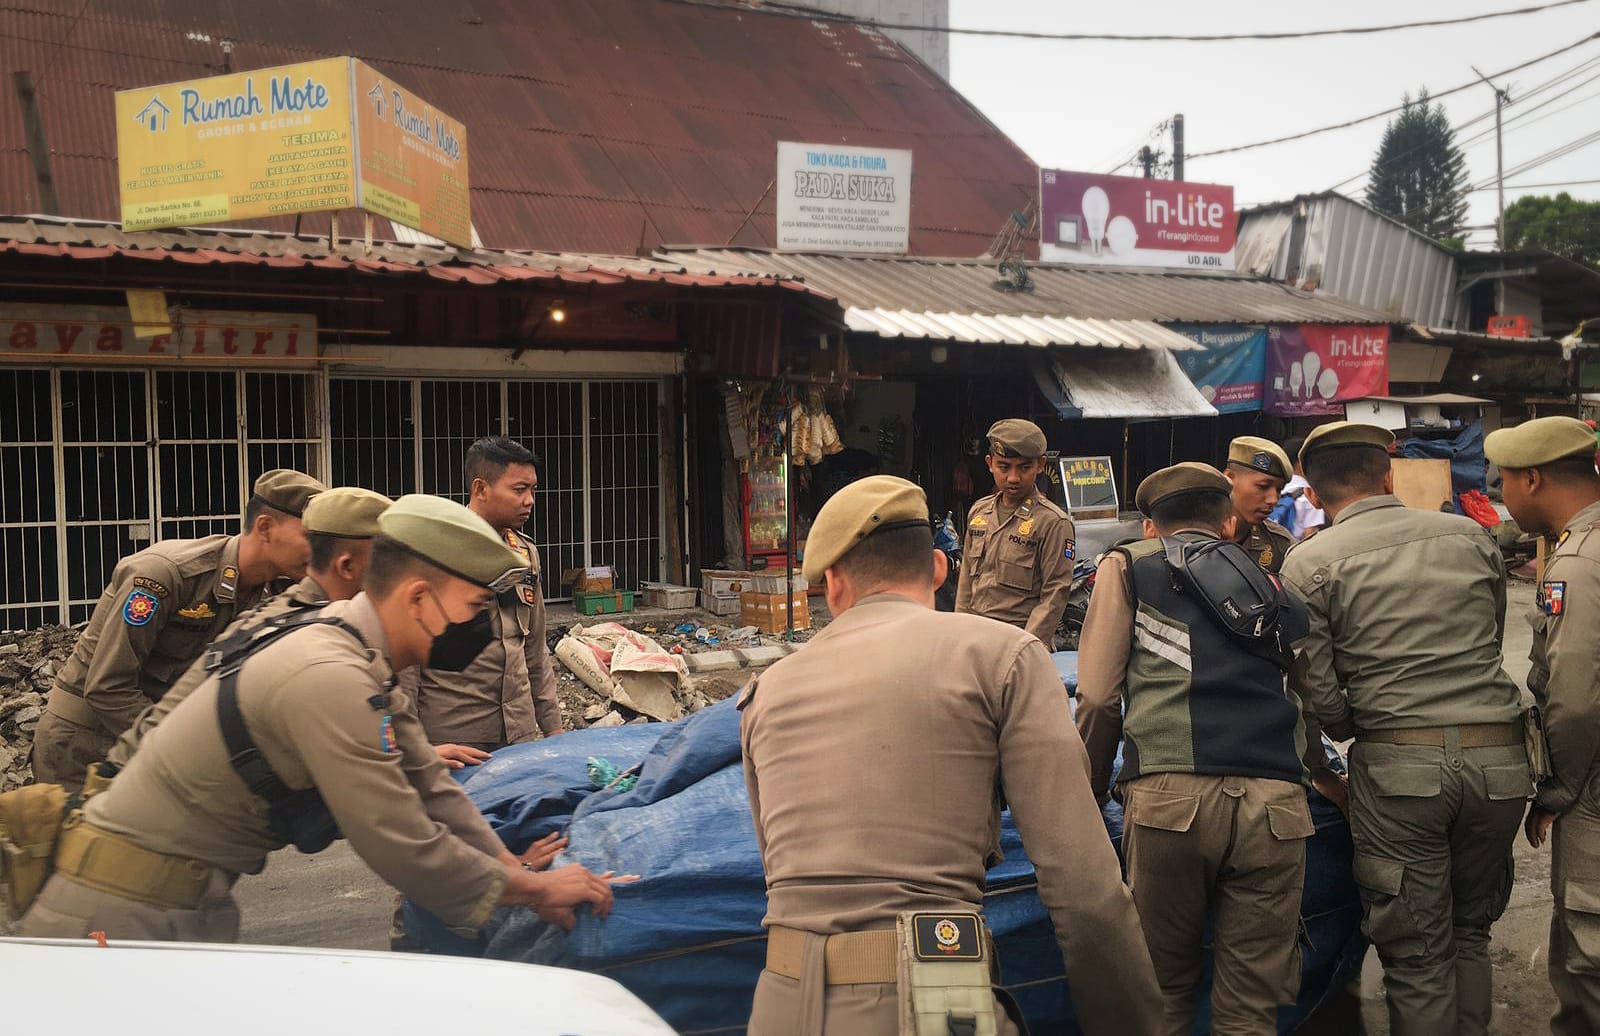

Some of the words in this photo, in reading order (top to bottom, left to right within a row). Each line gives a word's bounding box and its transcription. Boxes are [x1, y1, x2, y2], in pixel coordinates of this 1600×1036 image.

[181, 77, 263, 125] Rumah
[270, 76, 329, 111] Mote
[197, 124, 245, 139] GROSIR
[392, 88, 432, 144] Rumah
[434, 116, 460, 160] Mote
[282, 131, 339, 146] TERIMA
[268, 152, 308, 163] JAHITAN
[309, 146, 346, 157] WANITA
[806, 152, 827, 167] TOKO
[828, 154, 850, 168] KACA
[859, 156, 887, 170] FIGURA
[795, 171, 845, 200] PADA
[848, 174, 896, 203] SUKA
[1157, 230, 1220, 243] #TerangIndonesia
[1187, 255, 1201, 265] UD
[1202, 255, 1223, 266] ADIL
[570, 652, 603, 684] CONCH
